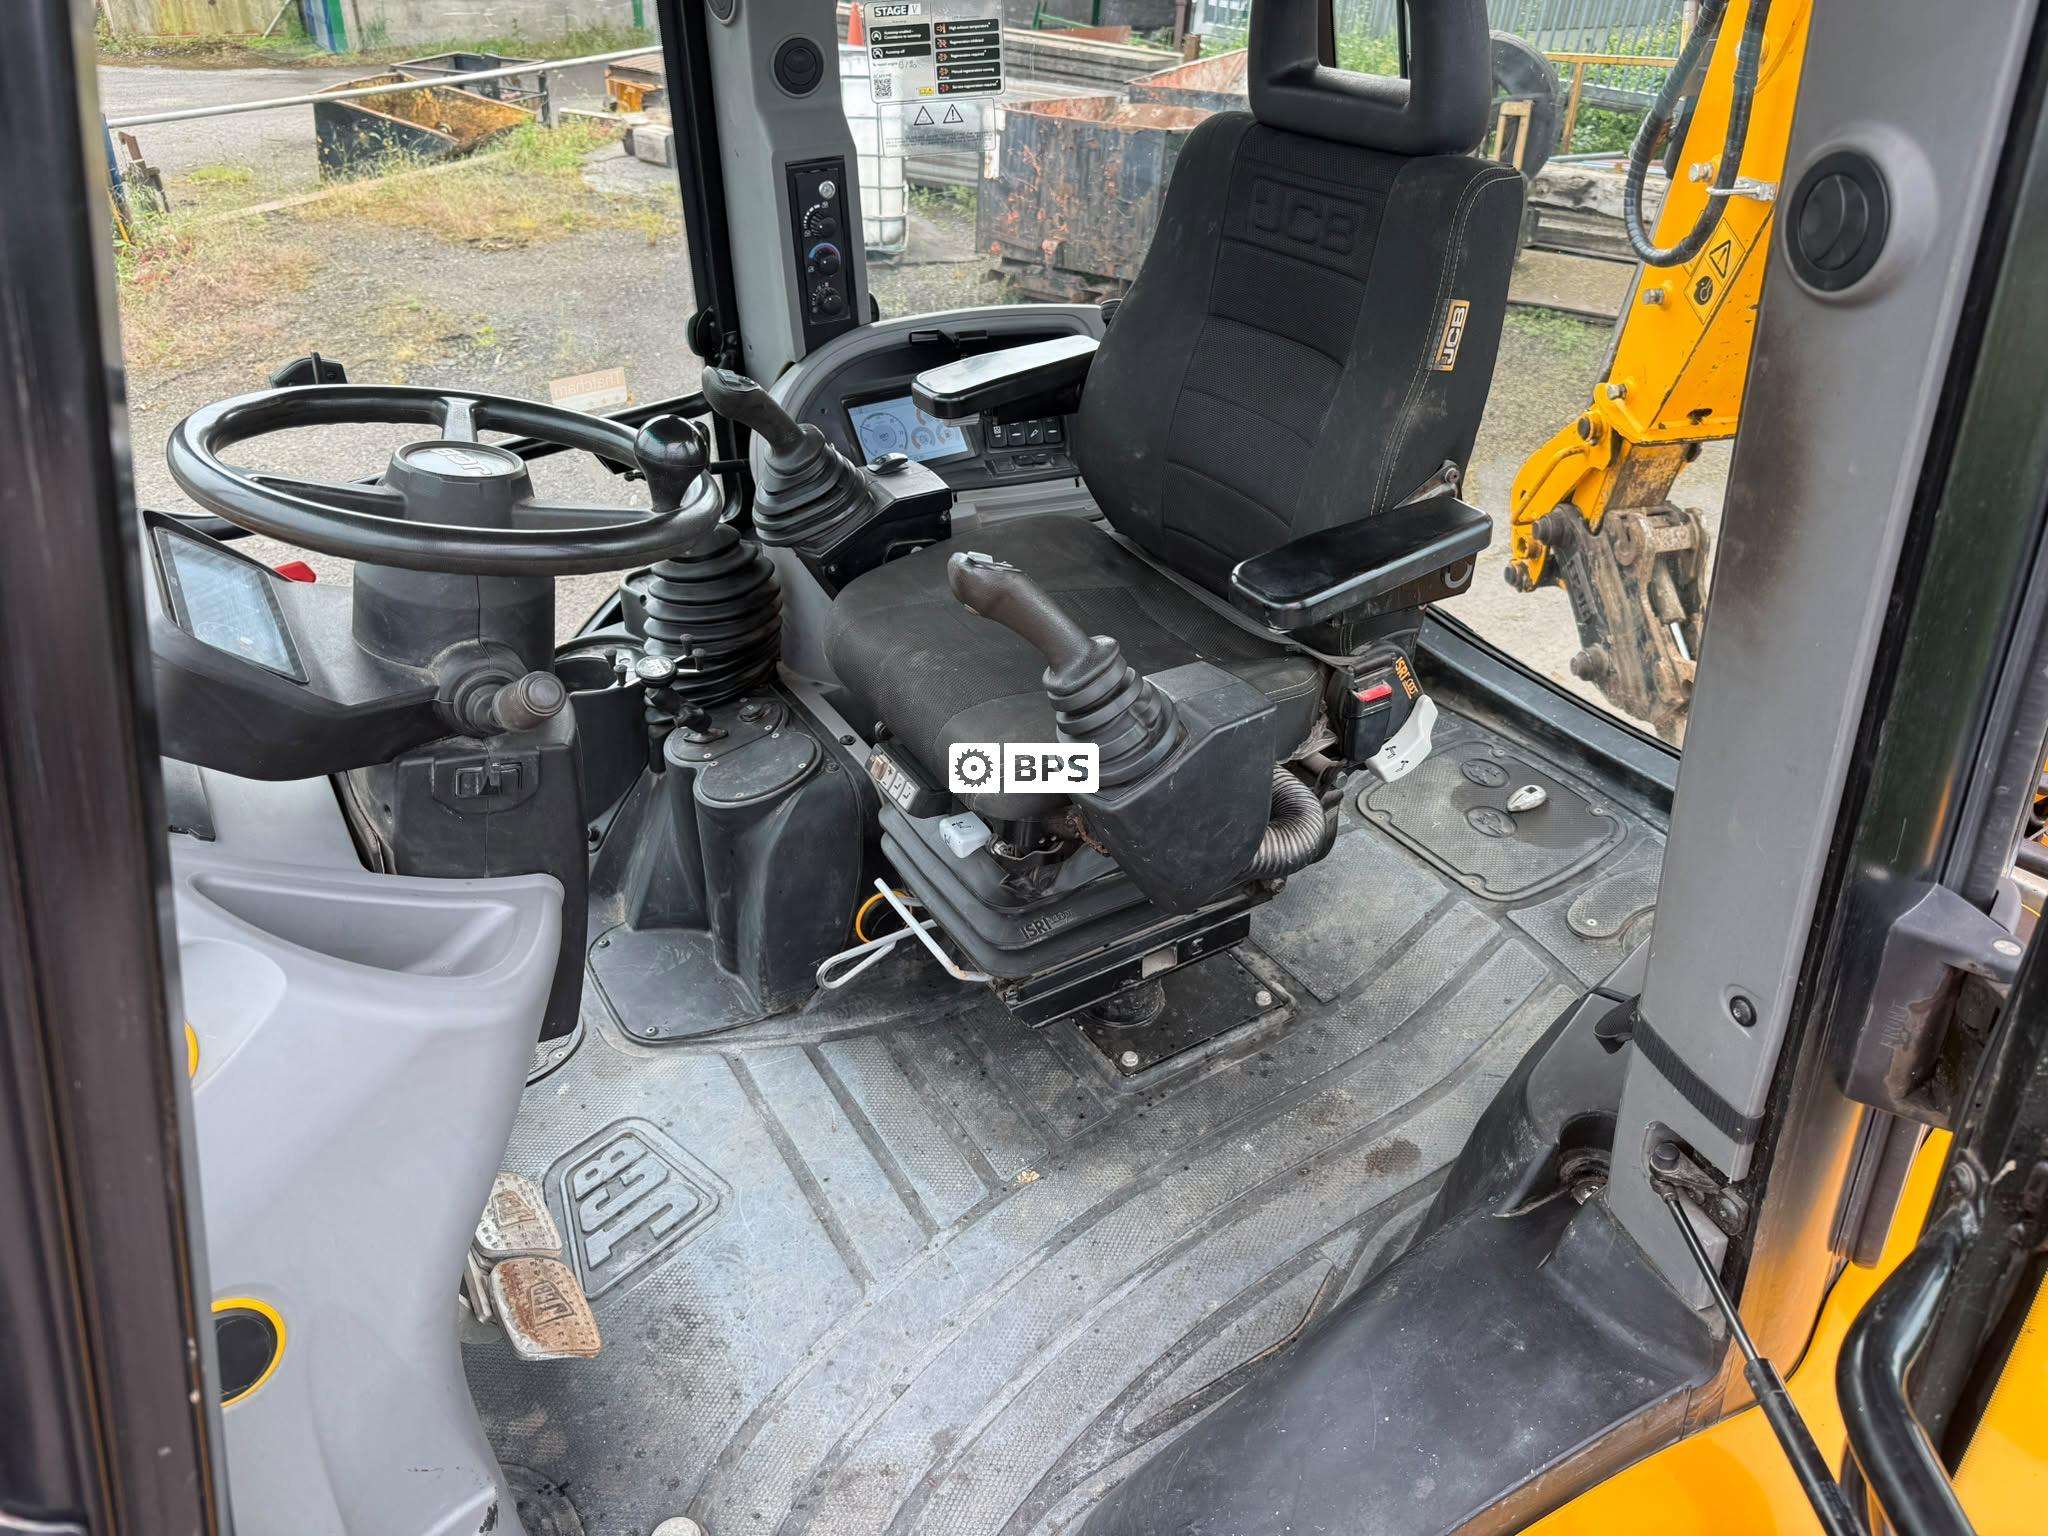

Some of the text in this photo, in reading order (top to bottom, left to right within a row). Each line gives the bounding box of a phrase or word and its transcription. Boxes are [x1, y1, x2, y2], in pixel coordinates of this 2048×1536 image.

[874, 6, 907, 16] STAGE
[1252, 184, 1357, 256] JCB
[1440, 306, 1466, 366] JCB
[573, 1138, 700, 1272] JCB
